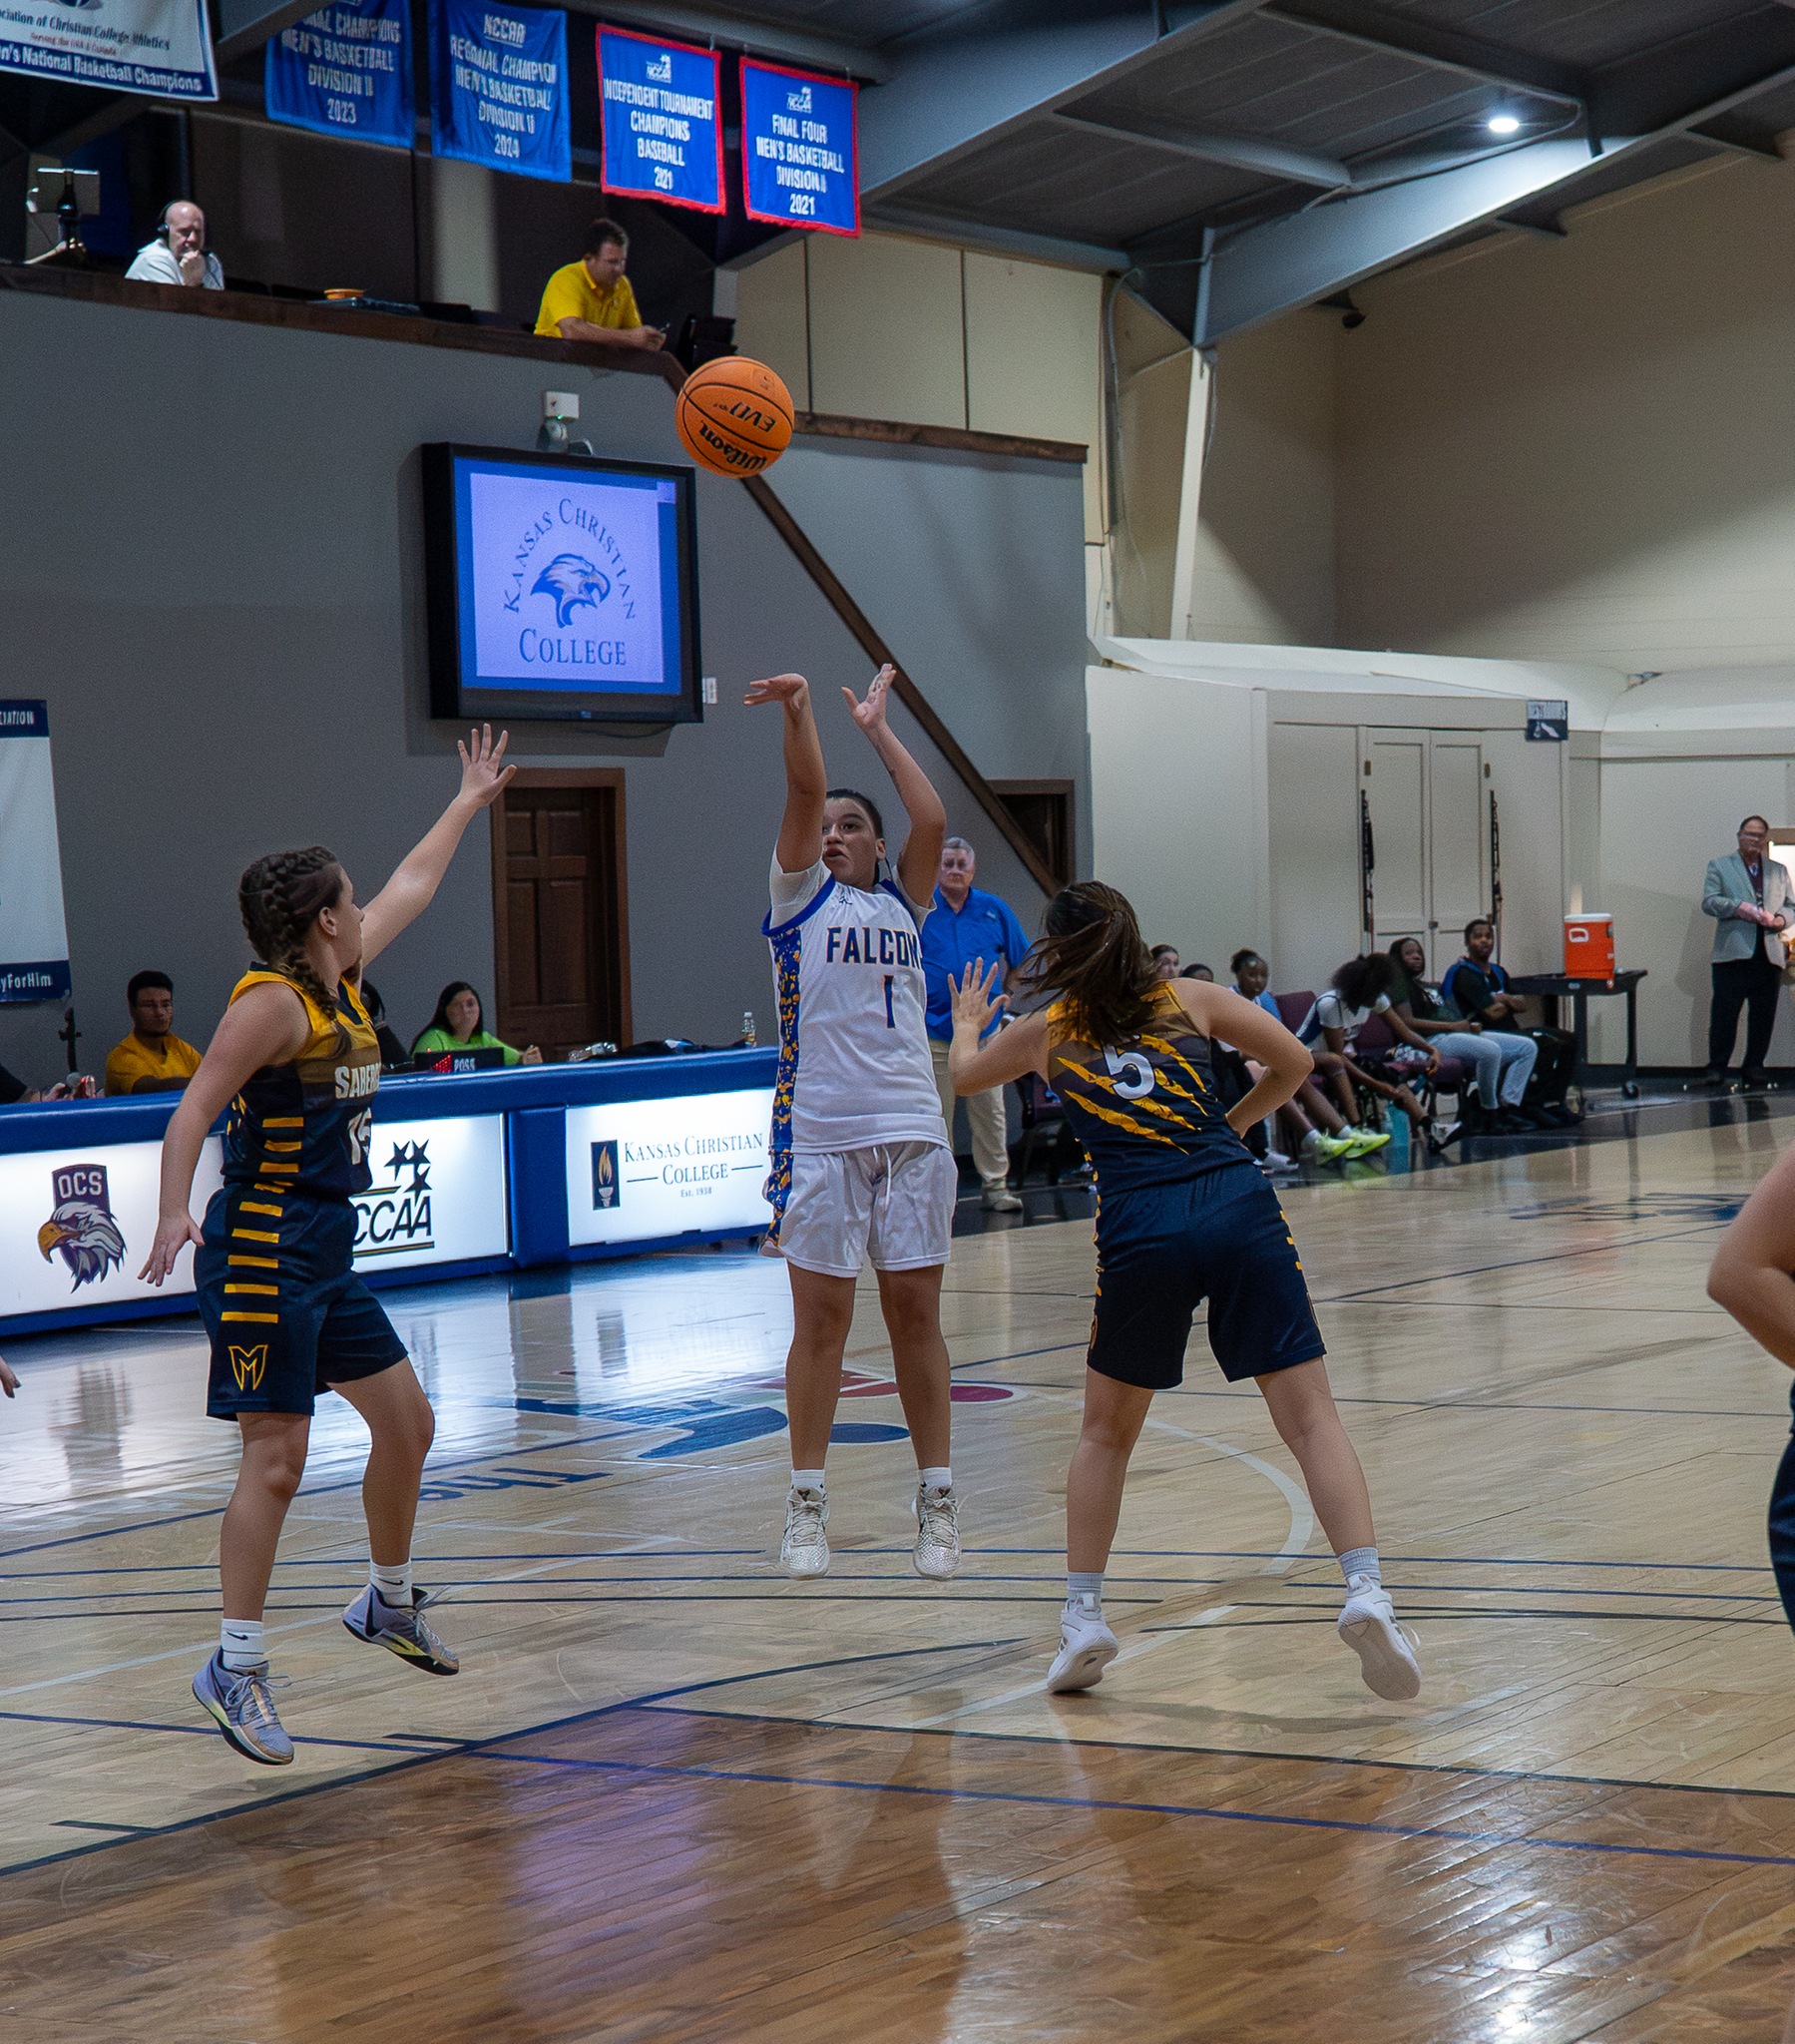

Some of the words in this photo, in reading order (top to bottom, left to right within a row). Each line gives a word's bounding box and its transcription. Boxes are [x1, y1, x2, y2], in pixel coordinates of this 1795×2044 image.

[36, 15, 47, 27] of
[49, 16, 92, 36] Christian
[484, 14, 526, 44] NCCAA
[0, 43, 20, 63] n's
[22, 46, 72, 71] National
[74, 56, 133, 82] Basketball
[135, 67, 203, 93] Champions
[323, 39, 395, 72] BASKETBALL
[308, 64, 362, 96] DIVISION
[488, 78, 552, 111] BASKETBALL
[327, 98, 356, 125] 2023
[604, 78, 660, 109] INDEPENDENT
[660, 90, 714, 121] TOURNAMENT
[630, 110, 690, 142] CHAMPIONS
[772, 114, 800, 139] FINAL
[801, 121, 828, 145] FOUR
[494, 134, 520, 158] 2024
[637, 137, 685, 167] BASEBALL
[756, 136, 785, 161] MEN'S
[786, 143, 845, 174] BASKETBALL
[776, 166, 819, 192] DIVISION
[789, 194, 815, 216] 2021
[699, 420, 767, 470] Wilson
[503, 511, 553, 614] KANSAS
[559, 498, 636, 620] CHRISTIAN
[519, 628, 627, 666] COLLEGE
[0, 711, 34, 726] IATION
[826, 926, 920, 970] FALCON
[0, 972, 52, 993] yForHim
[883, 974, 895, 1029] 1
[1103, 1035, 1154, 1099] 5
[625, 1142, 680, 1163] KANSAS
[684, 1133, 763, 1156] CHRISTIAN
[58, 1172, 102, 1199] OCS
[663, 1163, 728, 1185] COLLEGE
[680, 1189, 693, 1198] Est.
[695, 1187, 712, 1197] 1938
[353, 1196, 432, 1246] CCAA
